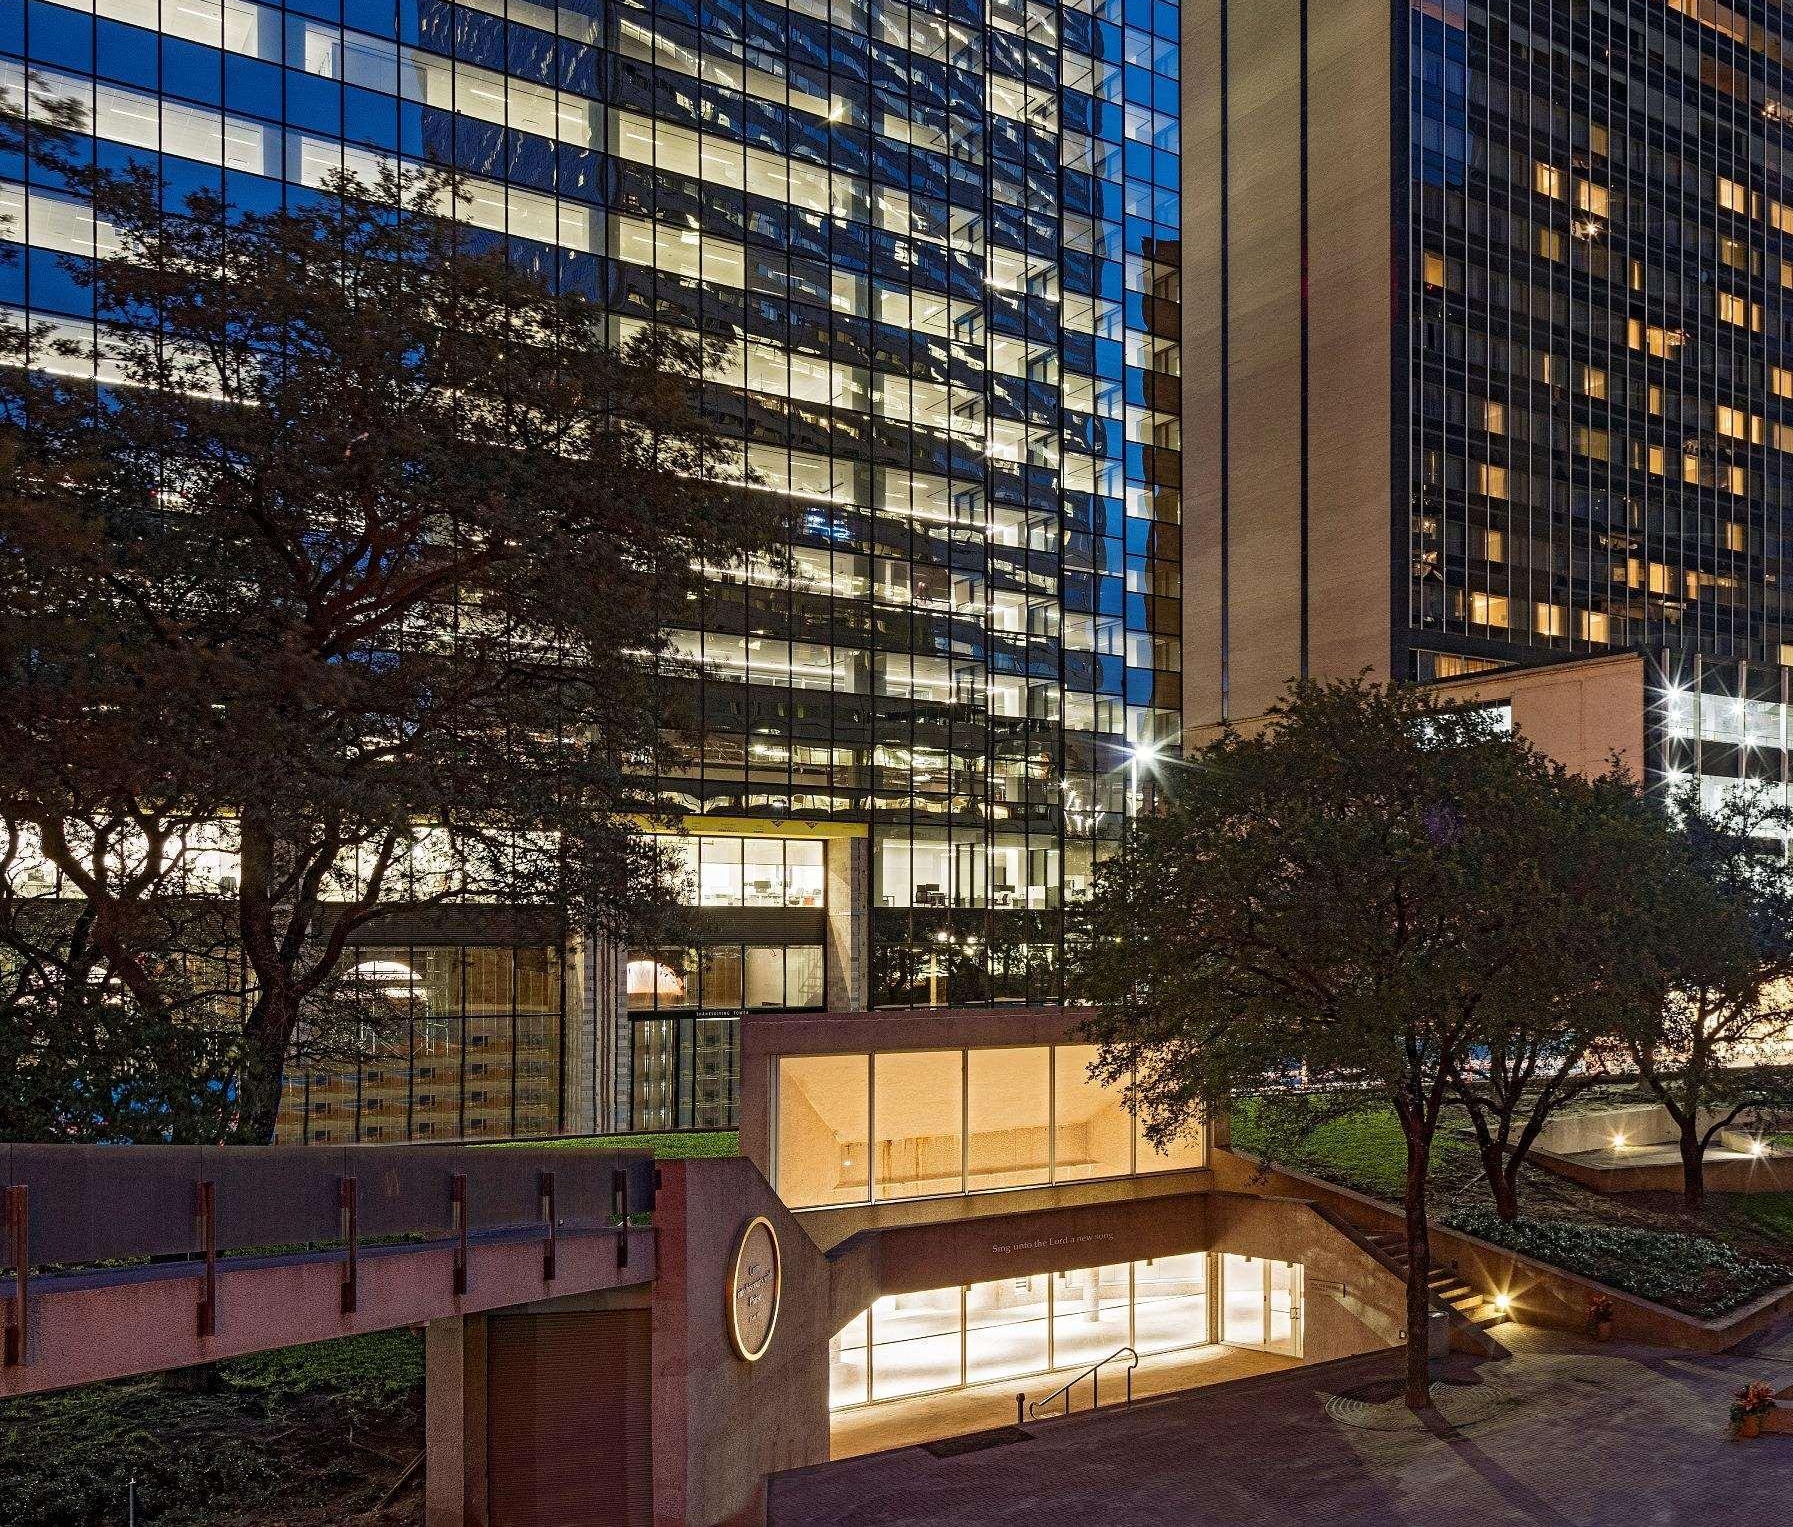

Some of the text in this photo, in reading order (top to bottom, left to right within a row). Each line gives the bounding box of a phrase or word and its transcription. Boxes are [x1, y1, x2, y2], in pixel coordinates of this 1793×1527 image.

[992, 1244, 1011, 1253] Sing
[1013, 1242, 1032, 1250] unto
[1034, 1239, 1047, 1248] the
[1049, 1236, 1068, 1246] Lord
[1094, 1233, 1114, 1241] song
